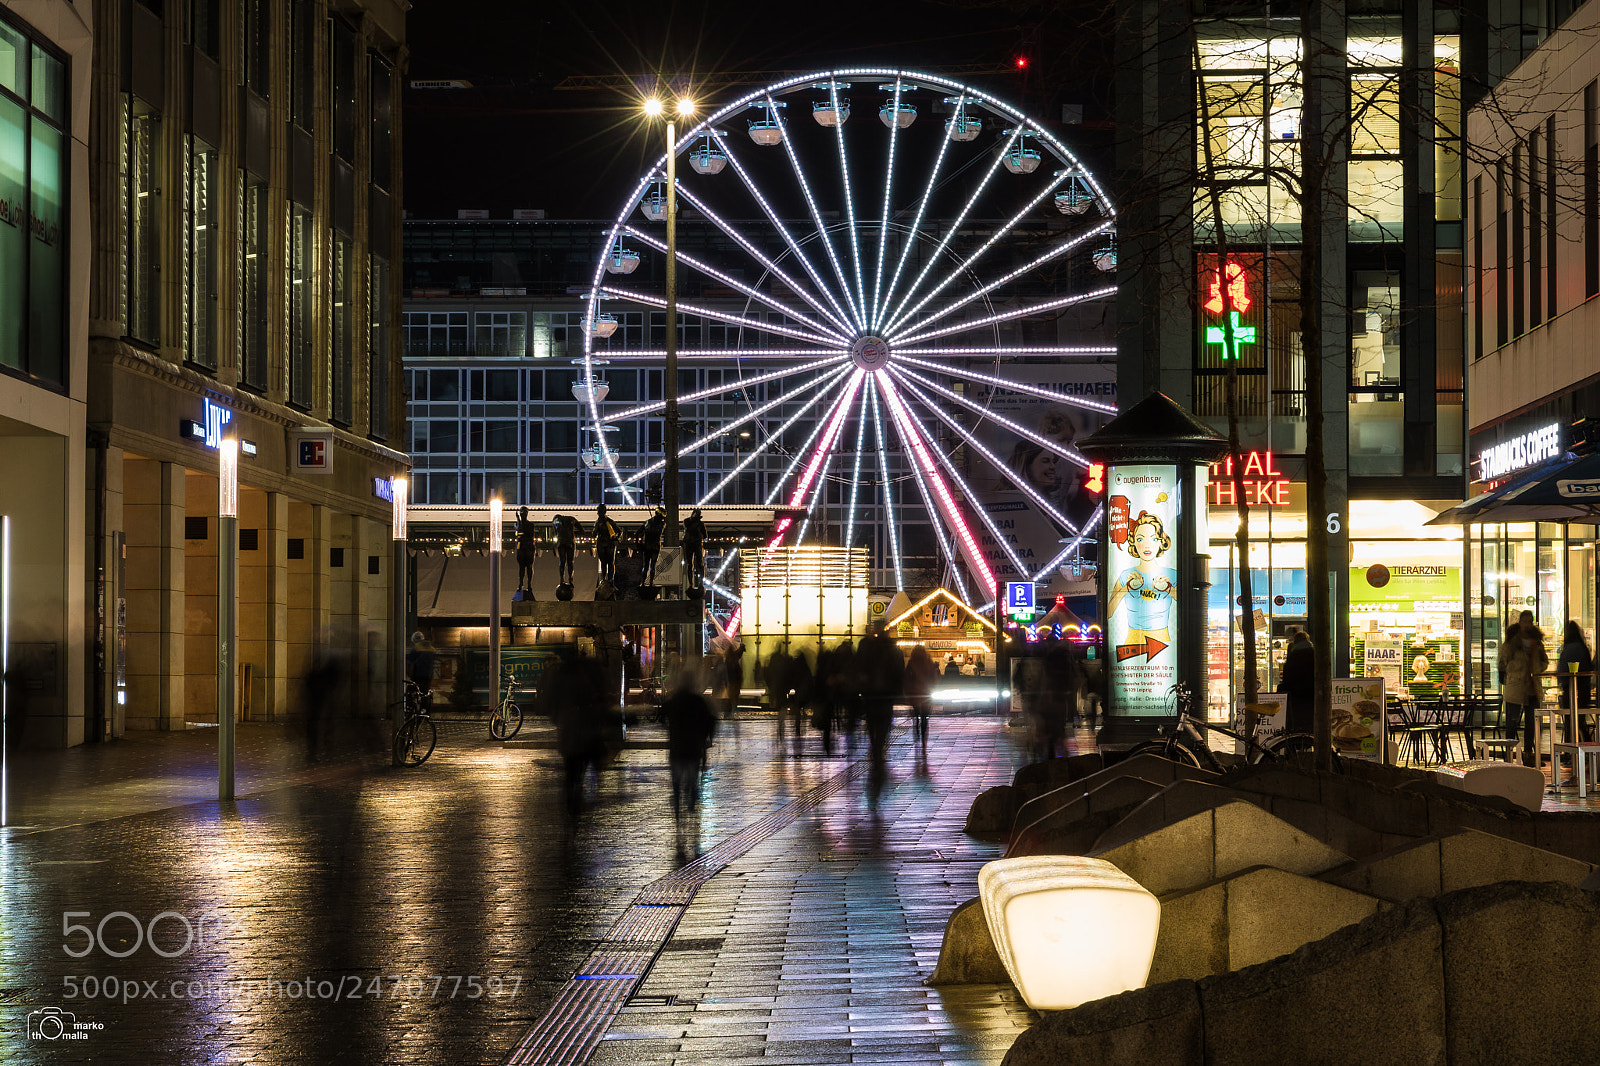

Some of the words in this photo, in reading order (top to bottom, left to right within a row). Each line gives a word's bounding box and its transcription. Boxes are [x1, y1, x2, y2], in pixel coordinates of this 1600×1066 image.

[1526, 422, 1559, 465] COFFEE
[1123, 475, 1162, 485] augenlaser
[1326, 512, 1341, 534] 6
[1392, 565, 1447, 575] TIERARZNEI
[1016, 588, 1025, 601] P
[1367, 648, 1401, 659] HAAR-
[1335, 684, 1364, 695] frisch
